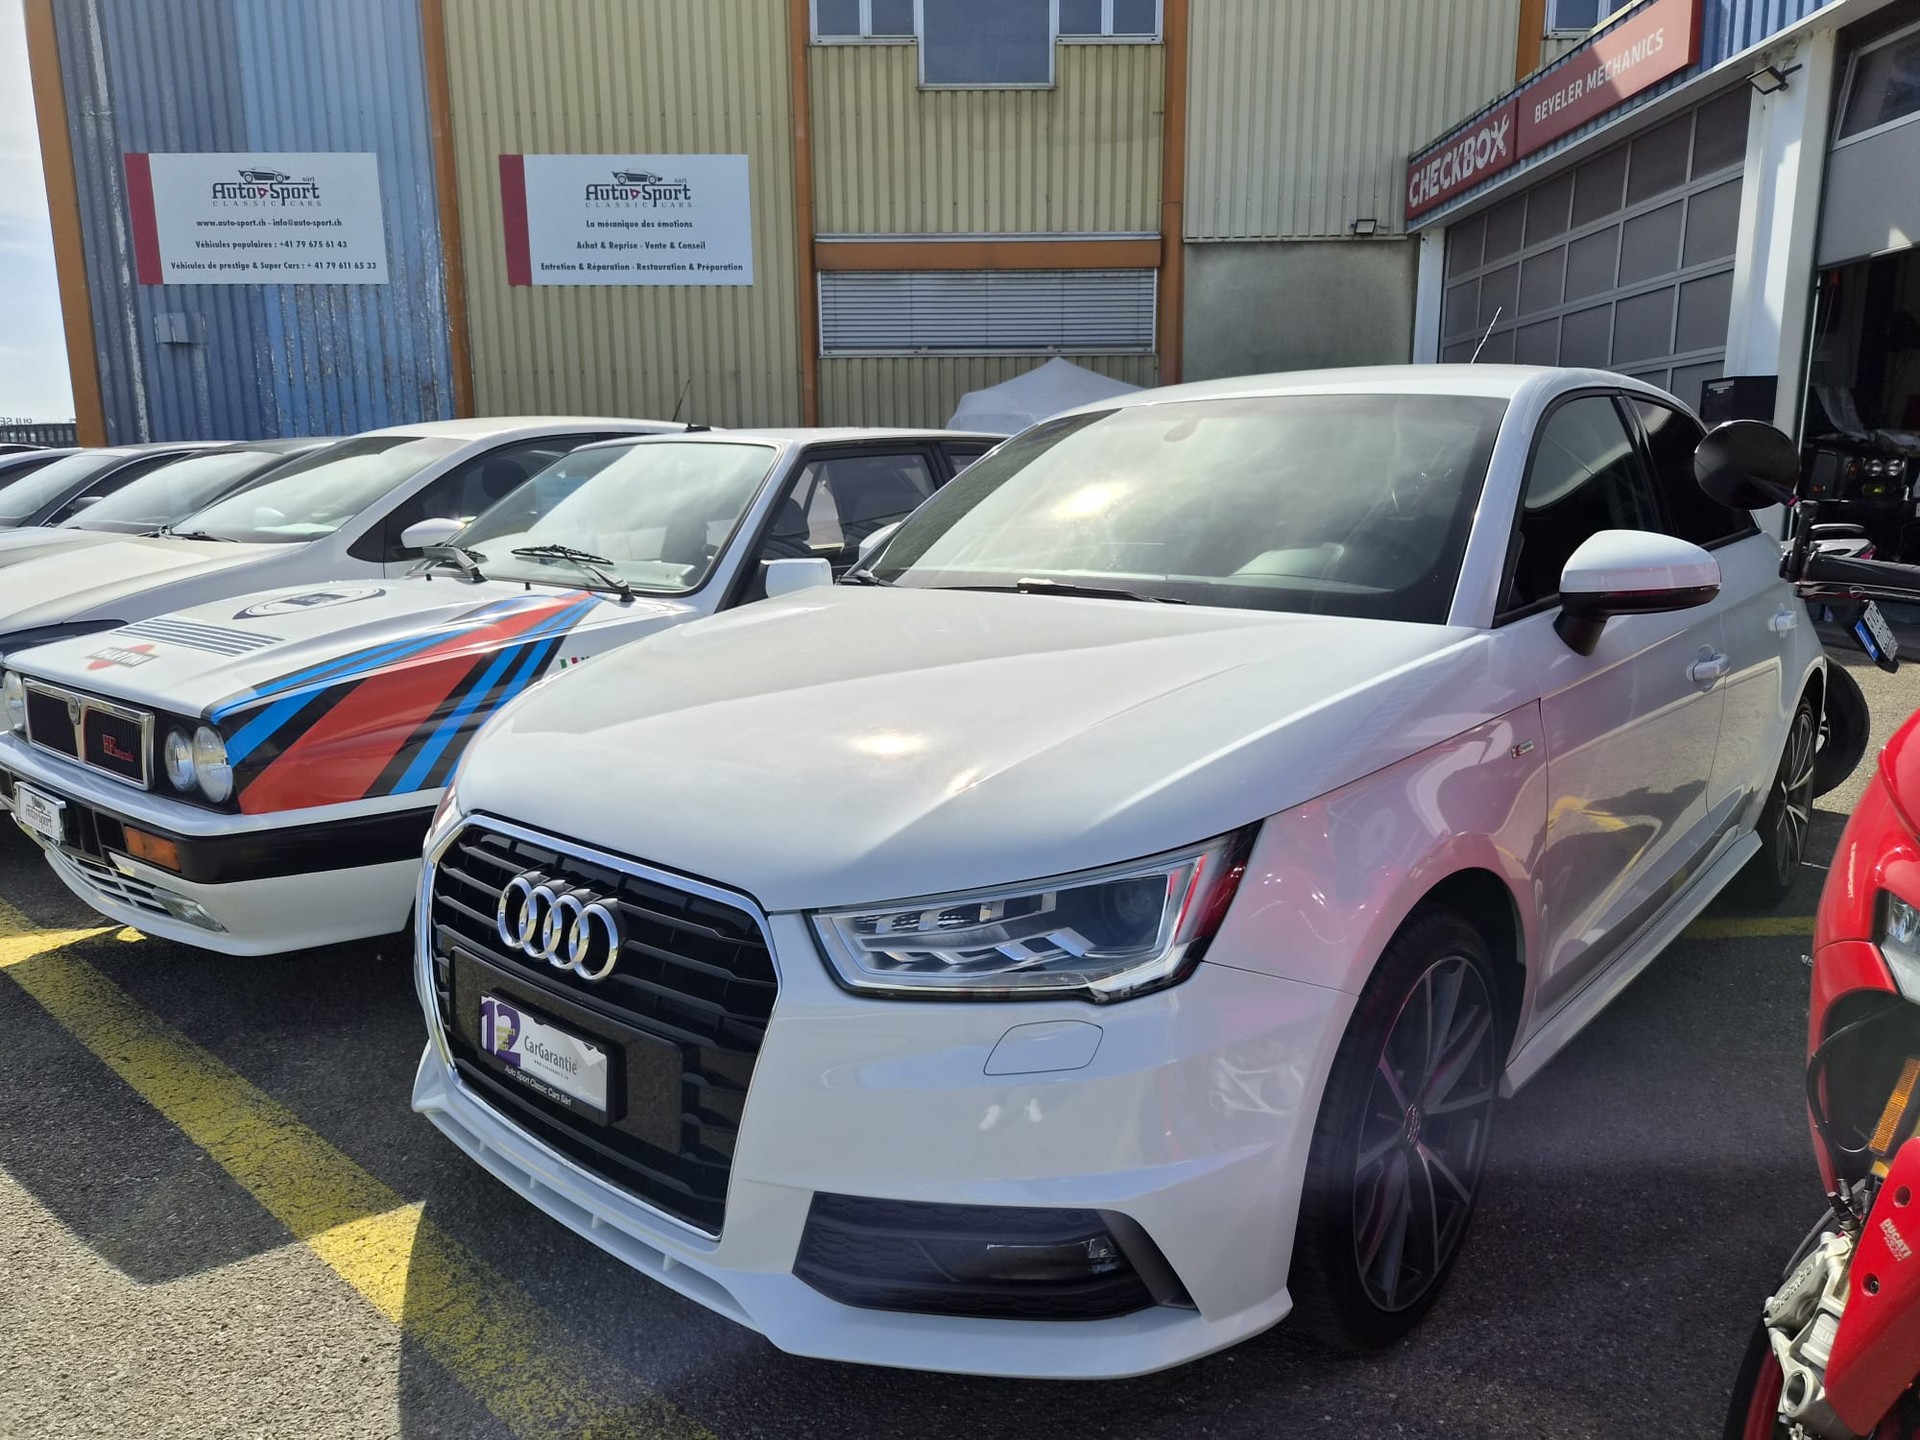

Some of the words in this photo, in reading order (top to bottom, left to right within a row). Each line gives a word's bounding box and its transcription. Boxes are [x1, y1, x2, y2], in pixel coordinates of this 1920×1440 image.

[1534, 79, 1583, 124] BEYELER
[1586, 28, 1665, 93] MECHANICS
[1408, 114, 1510, 208] CHECKBOX
[212, 182, 255, 200] Auto
[269, 182, 320, 206] Sport
[585, 184, 629, 201] Auto
[641, 184, 692, 208] Sport
[196, 218, 266, 229] www.auto-sport.ch
[272, 218, 342, 229] info@auto-sport.ch
[586, 219, 596, 229] La
[597, 219, 639, 231] mécanique
[641, 219, 655, 229] des
[657, 219, 693, 229] émotions
[232, 240, 272, 251] populaires
[279, 240, 294, 249] +41
[296, 240, 307, 249] 79
[308, 240, 324, 249] 675
[325, 240, 335, 249] 61
[336, 240, 348, 249] 43
[576, 240, 598, 250] Achat
[600, 240, 607, 250] &
[609, 240, 638, 252] Reprise
[645, 240, 667, 250] Vente
[669, 241, 676, 250] &
[678, 240, 706, 250] Conseil
[208, 260, 218, 270] de
[219, 260, 250, 272] prestige
[252, 261, 259, 270] &
[260, 261, 282, 272] Super
[283, 261, 300, 270] Cars
[314, 261, 324, 270] 41
[326, 261, 337, 270] 79
[339, 261, 352, 270] 611
[353, 261, 365, 270] 65
[366, 261, 377, 270] 33
[540, 262, 576, 271] Entretien
[578, 262, 585, 271] &
[587, 261, 630, 273] Réparation
[636, 262, 686, 272] Restauration
[688, 262, 695, 271] &
[697, 262, 744, 274] Préparation
[479, 1000, 521, 1067] 12
[524, 1035, 577, 1076] CarGarantie
[504, 1065, 516, 1078] Auto
[515, 1070, 530, 1086] Sport
[530, 1077, 548, 1095] Classic
[547, 1087, 560, 1101] Cars
[1880, 1218, 1912, 1257] DUCATI
